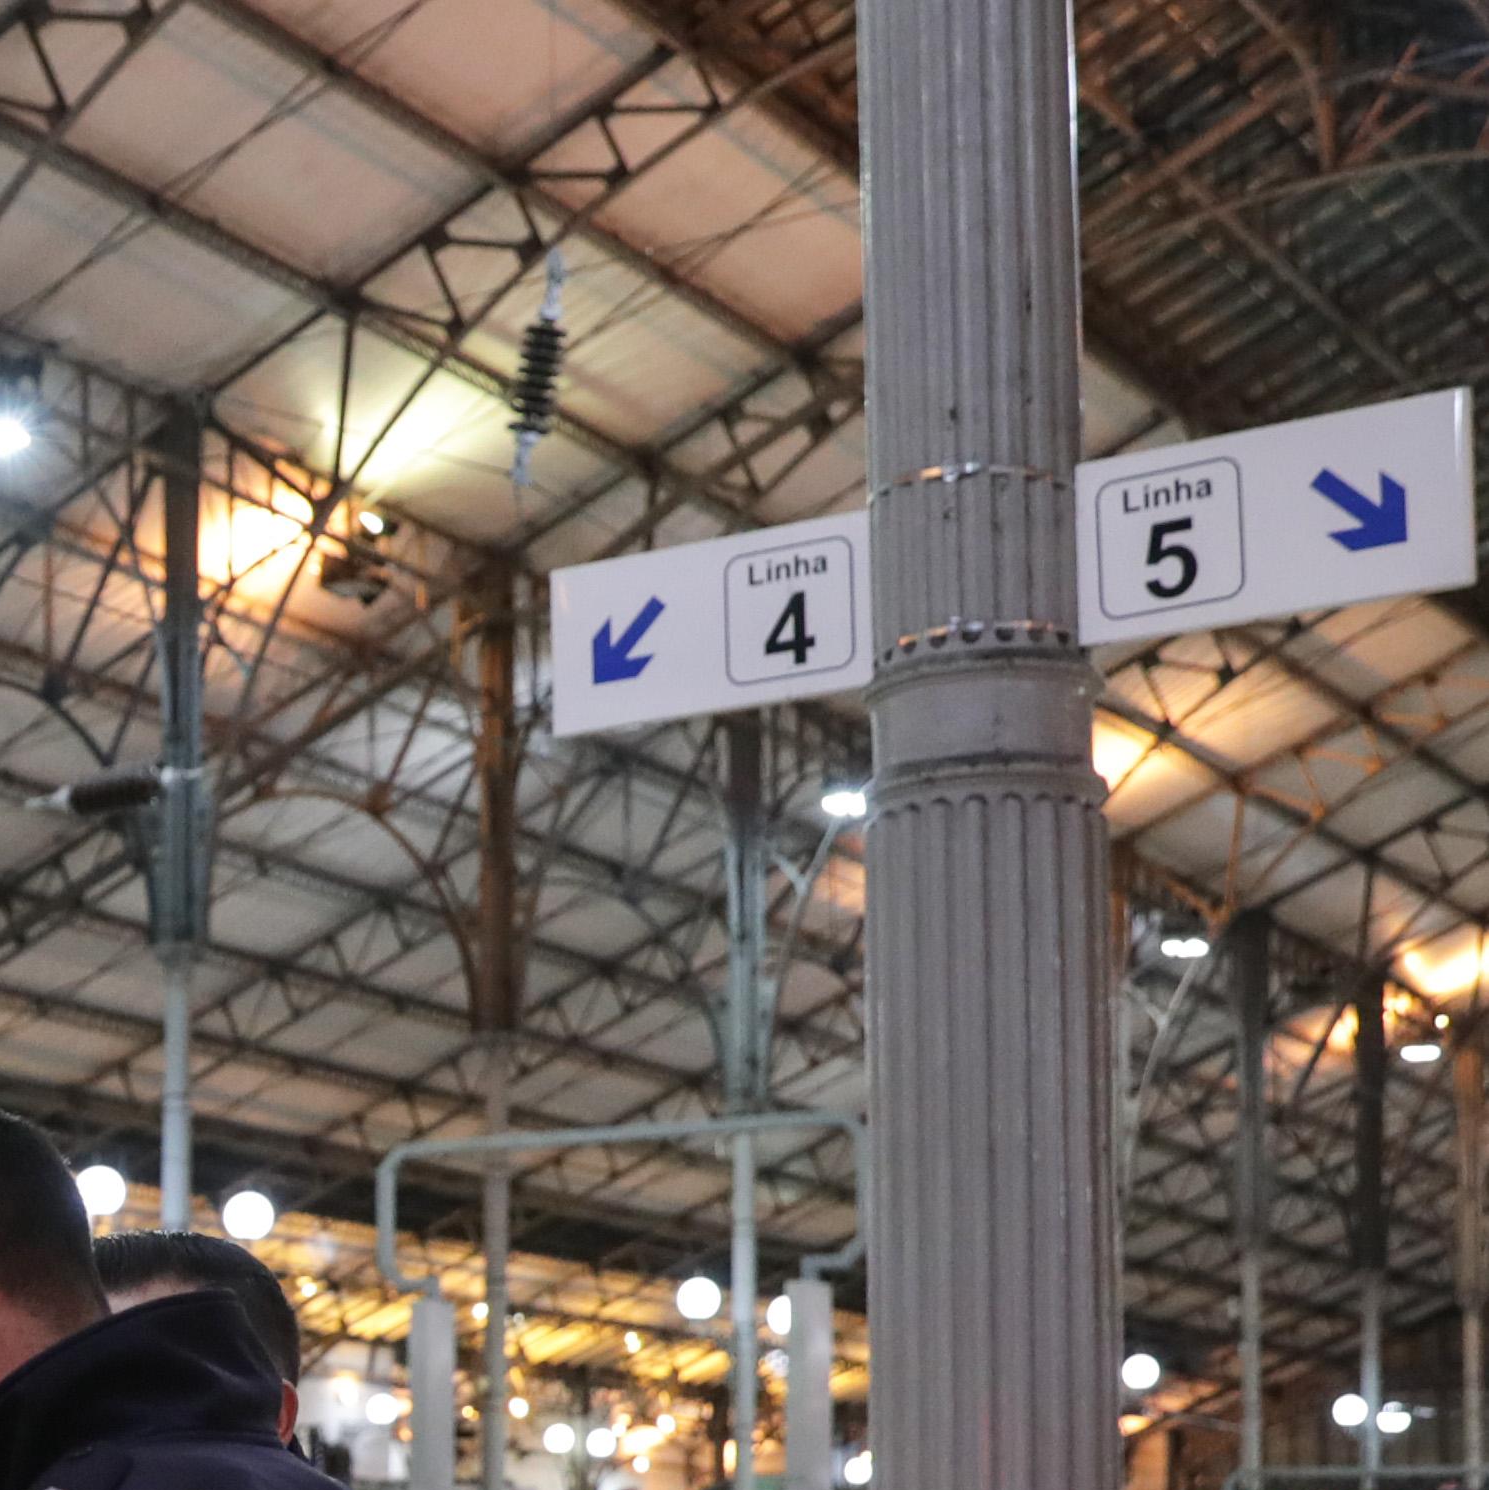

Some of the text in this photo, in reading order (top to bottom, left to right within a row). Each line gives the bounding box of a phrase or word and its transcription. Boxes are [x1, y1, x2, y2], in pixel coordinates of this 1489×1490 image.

[1121, 471, 1213, 515] Linha
[748, 555, 827, 586] Linha
[1145, 516, 1198, 599] 5
[764, 591, 816, 665] 4
